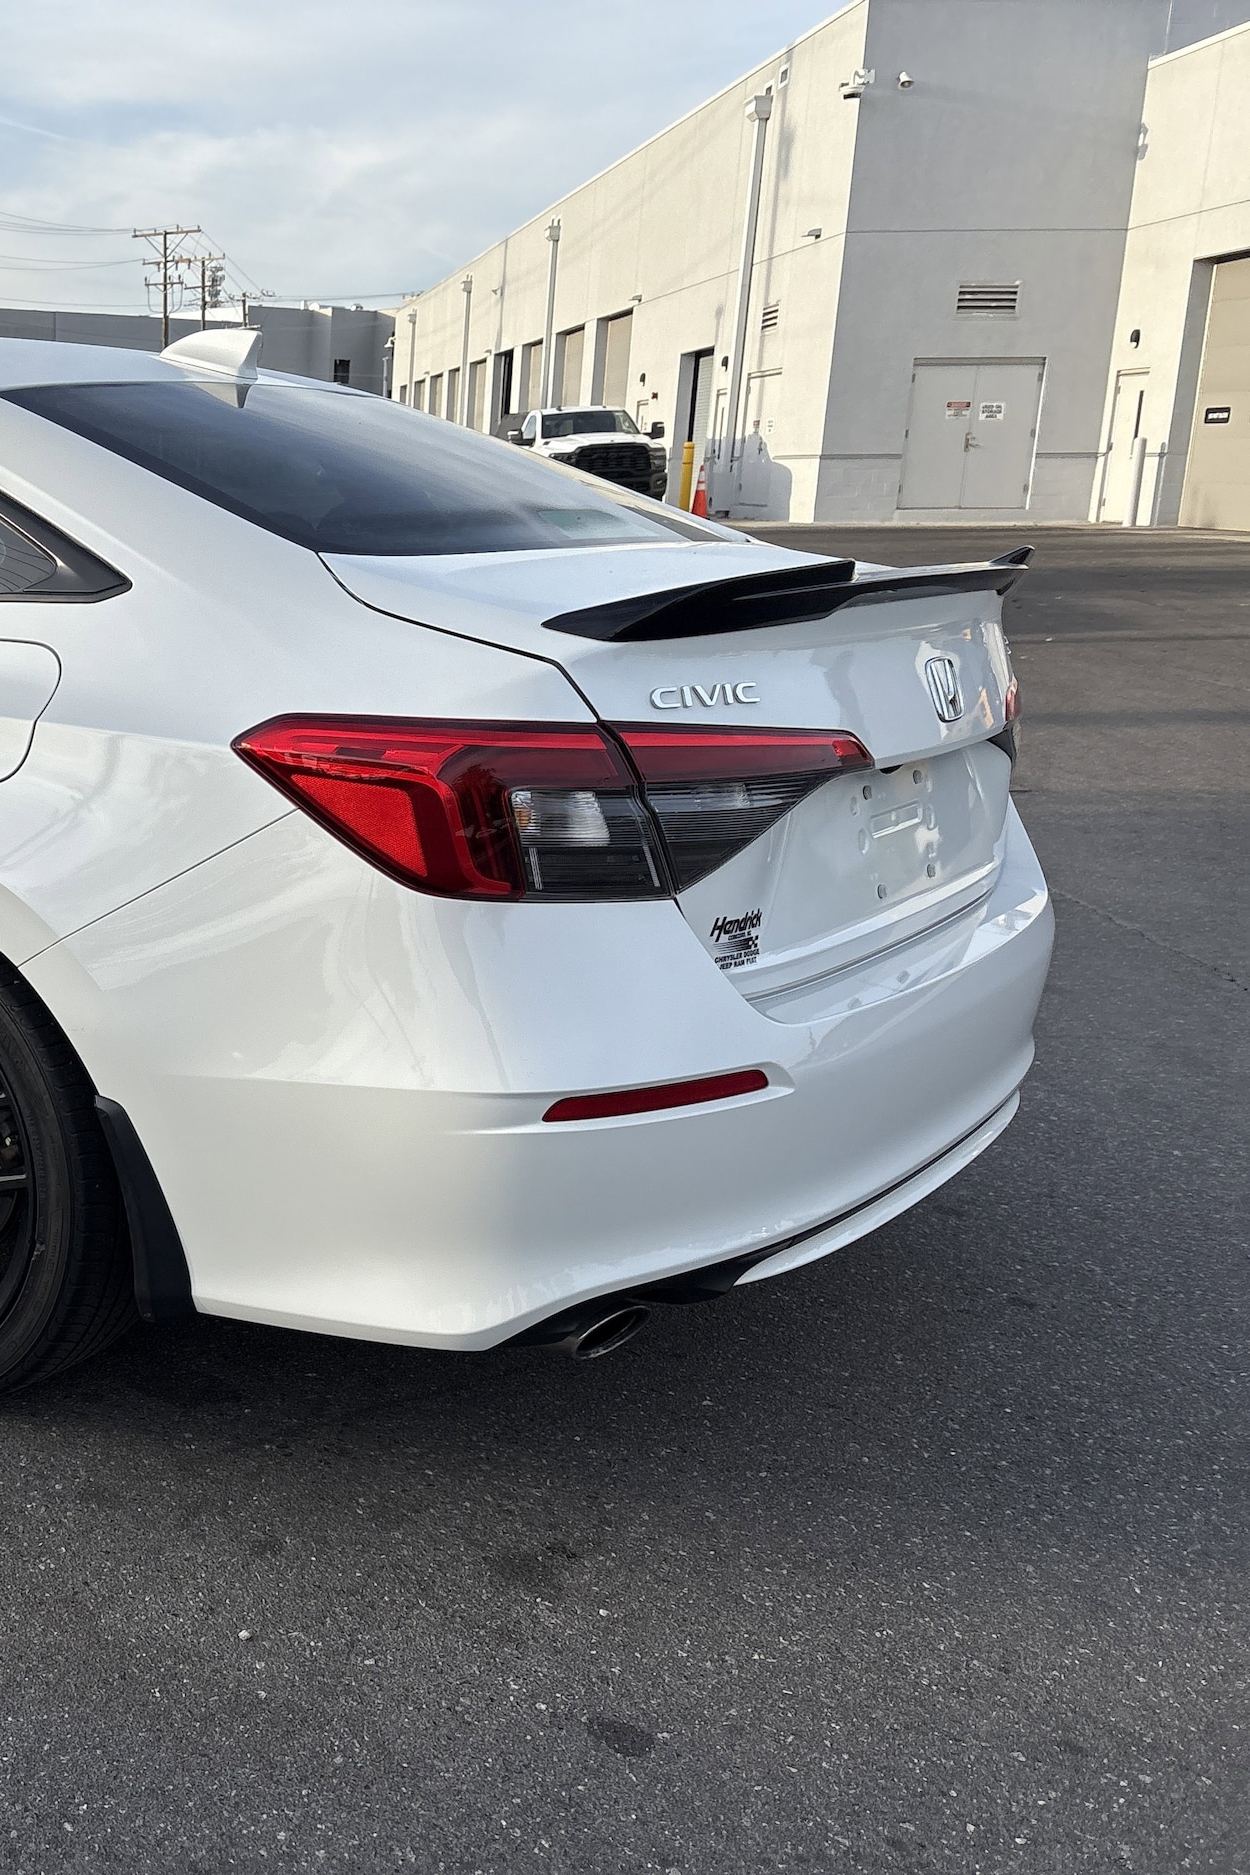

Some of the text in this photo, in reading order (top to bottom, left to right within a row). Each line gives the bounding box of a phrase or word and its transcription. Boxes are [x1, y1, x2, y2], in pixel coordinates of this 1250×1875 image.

[650, 682, 761, 709] CIVIC
[709, 908, 763, 943] Hendrick
[714, 952, 743, 964] CHRYSLER
